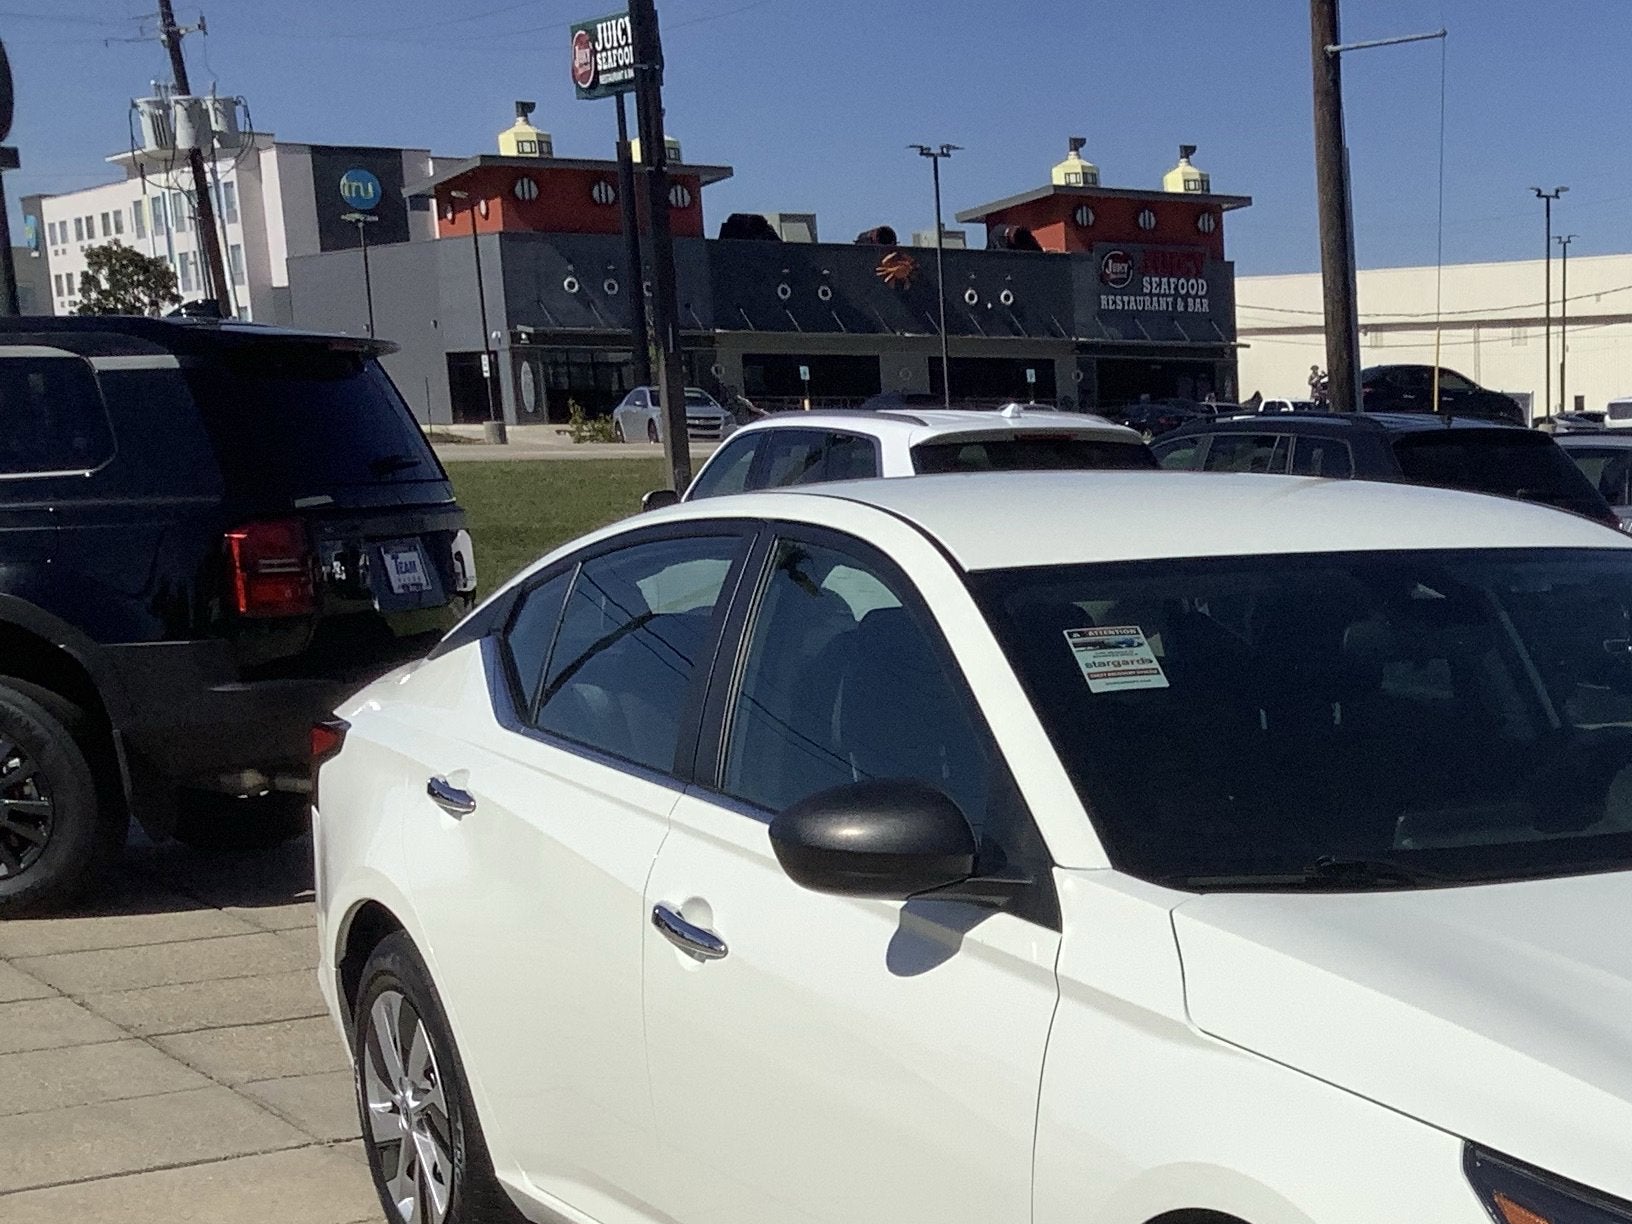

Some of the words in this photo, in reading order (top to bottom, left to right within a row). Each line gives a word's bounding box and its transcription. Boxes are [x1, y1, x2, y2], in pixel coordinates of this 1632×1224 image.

[1142, 276, 1208, 295] SEAFOOD
[1100, 295, 1173, 311] RESTAURANT
[1176, 298, 1184, 312] &
[1187, 298, 1209, 313] BAR
[1088, 628, 1137, 637] ATTENTION
